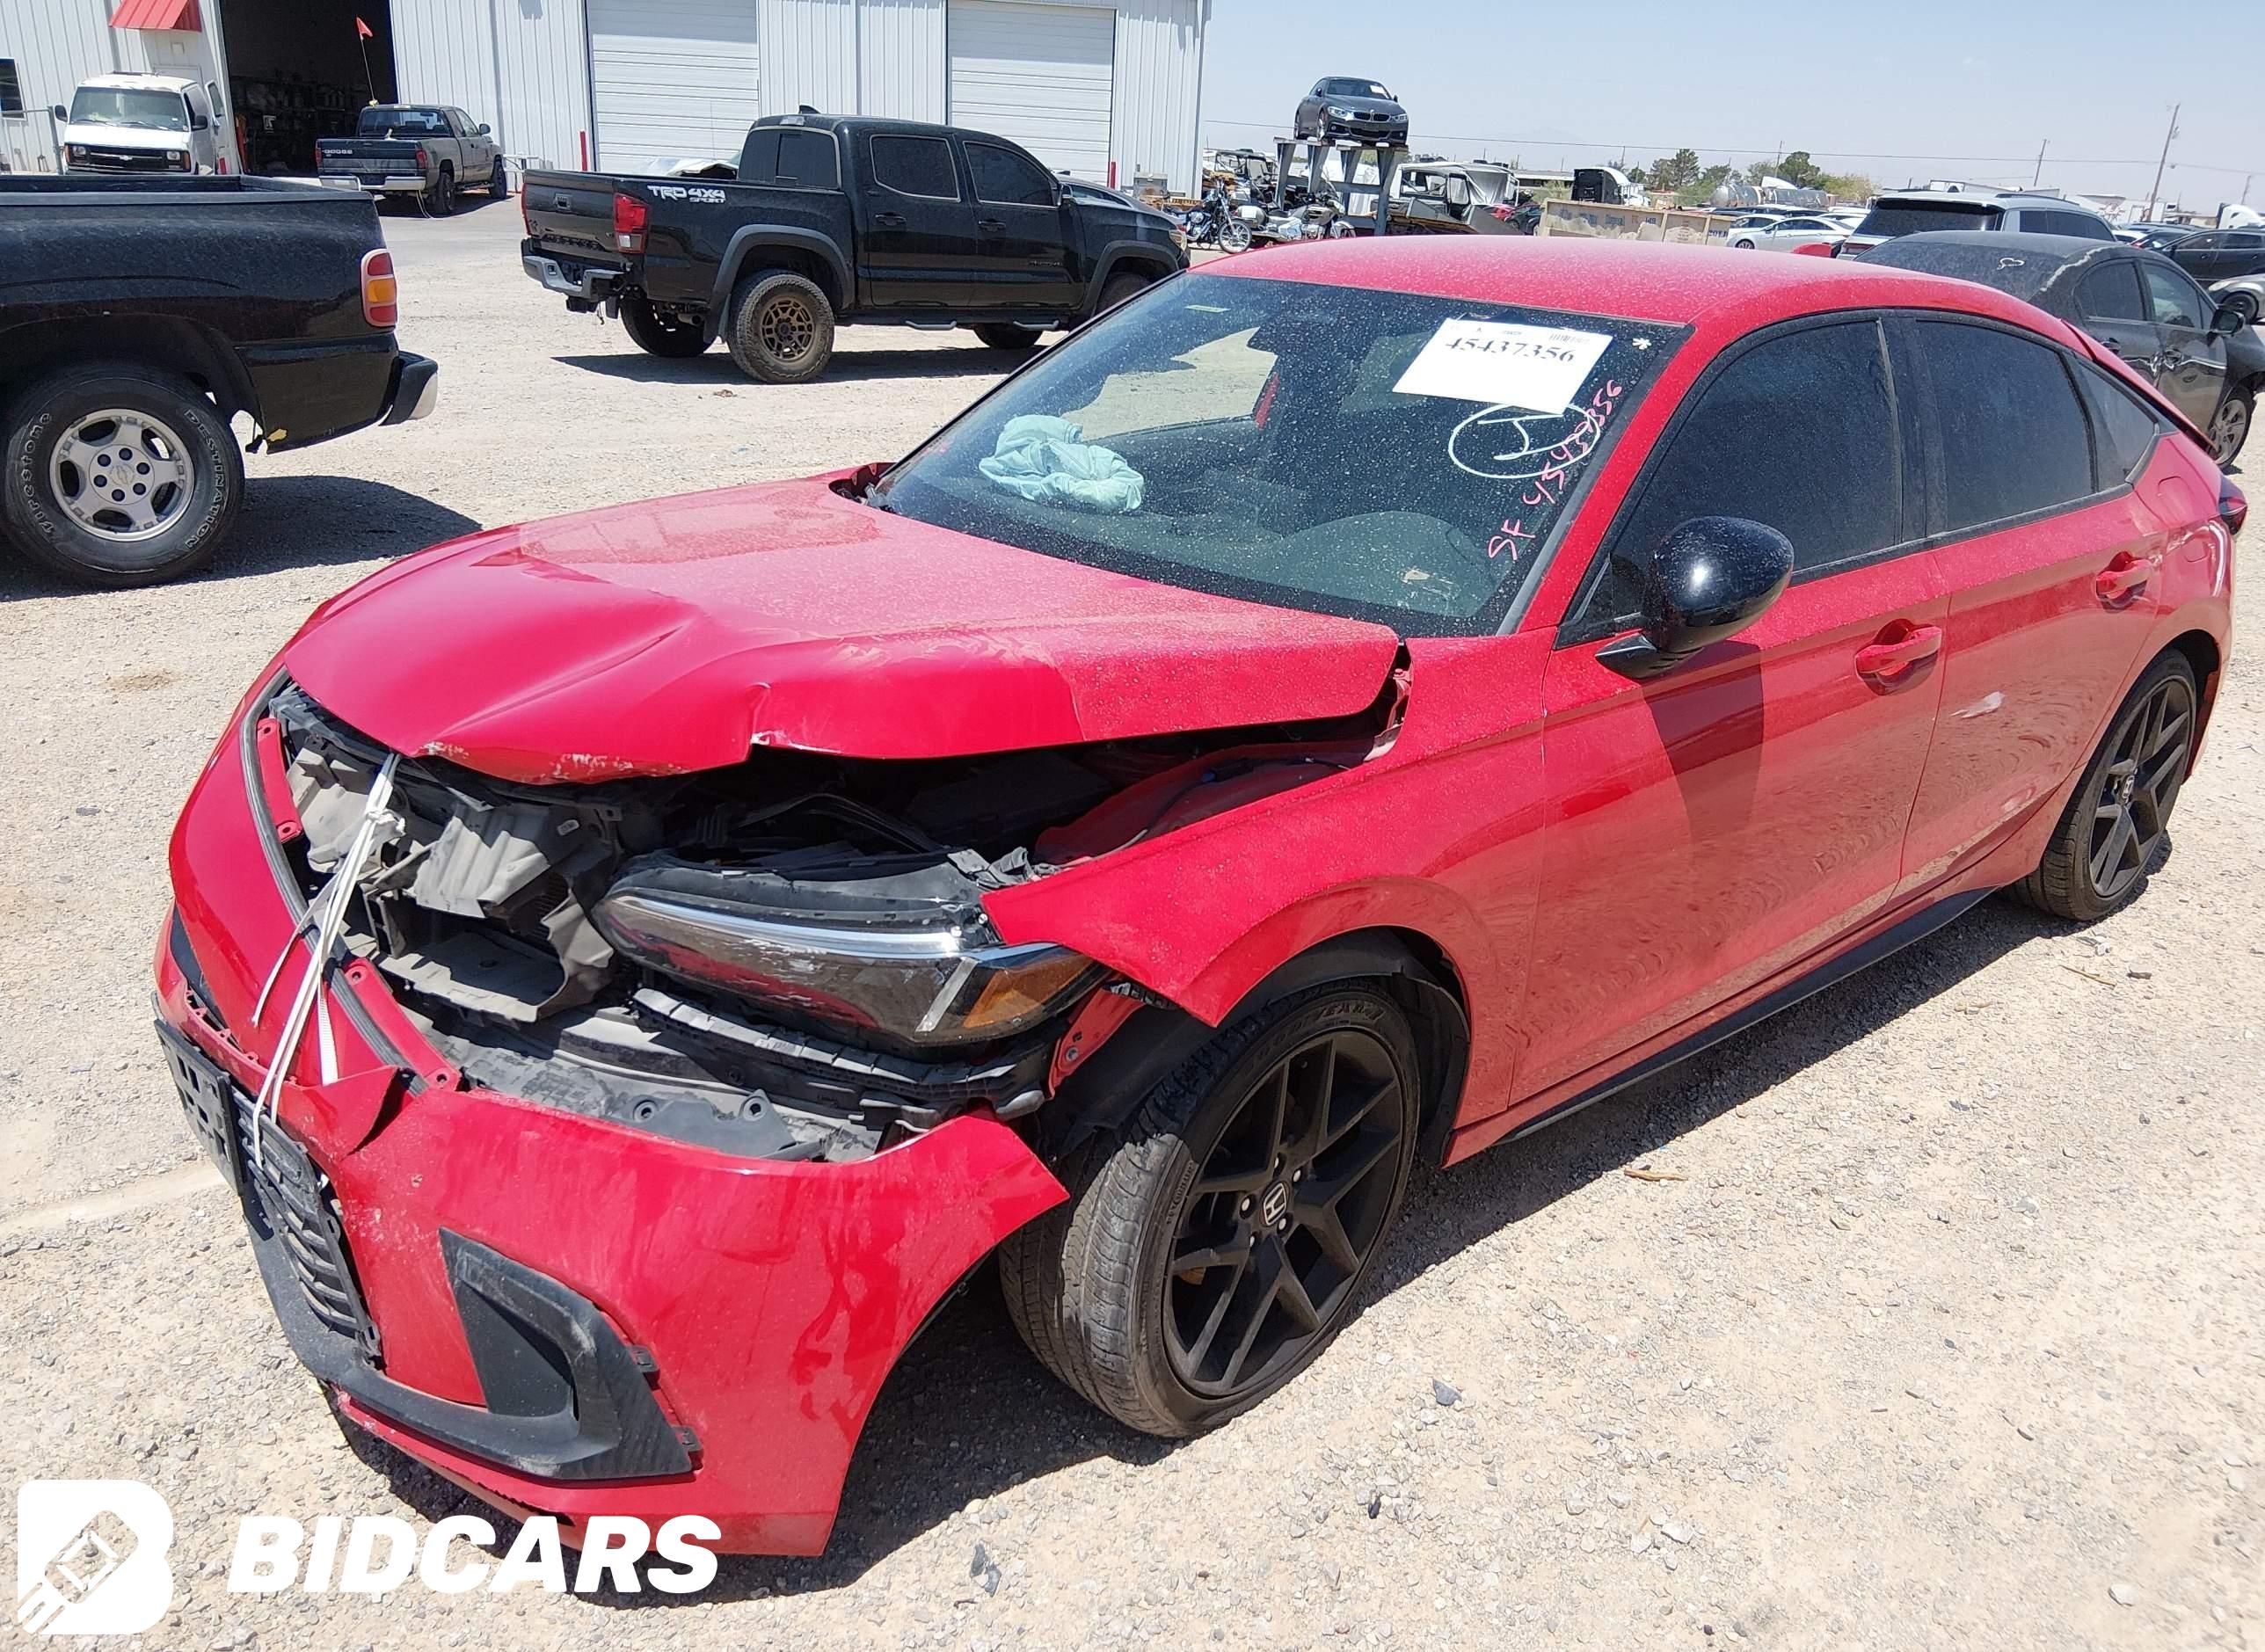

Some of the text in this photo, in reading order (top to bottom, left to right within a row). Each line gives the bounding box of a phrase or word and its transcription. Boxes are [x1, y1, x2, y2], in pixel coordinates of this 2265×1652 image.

[647, 186, 688, 200] TRD
[1446, 337, 1576, 362] 45437356
[20, 413, 56, 535] Firestone
[184, 410, 225, 549] DESTINATION
[1489, 519, 1536, 560] SF
